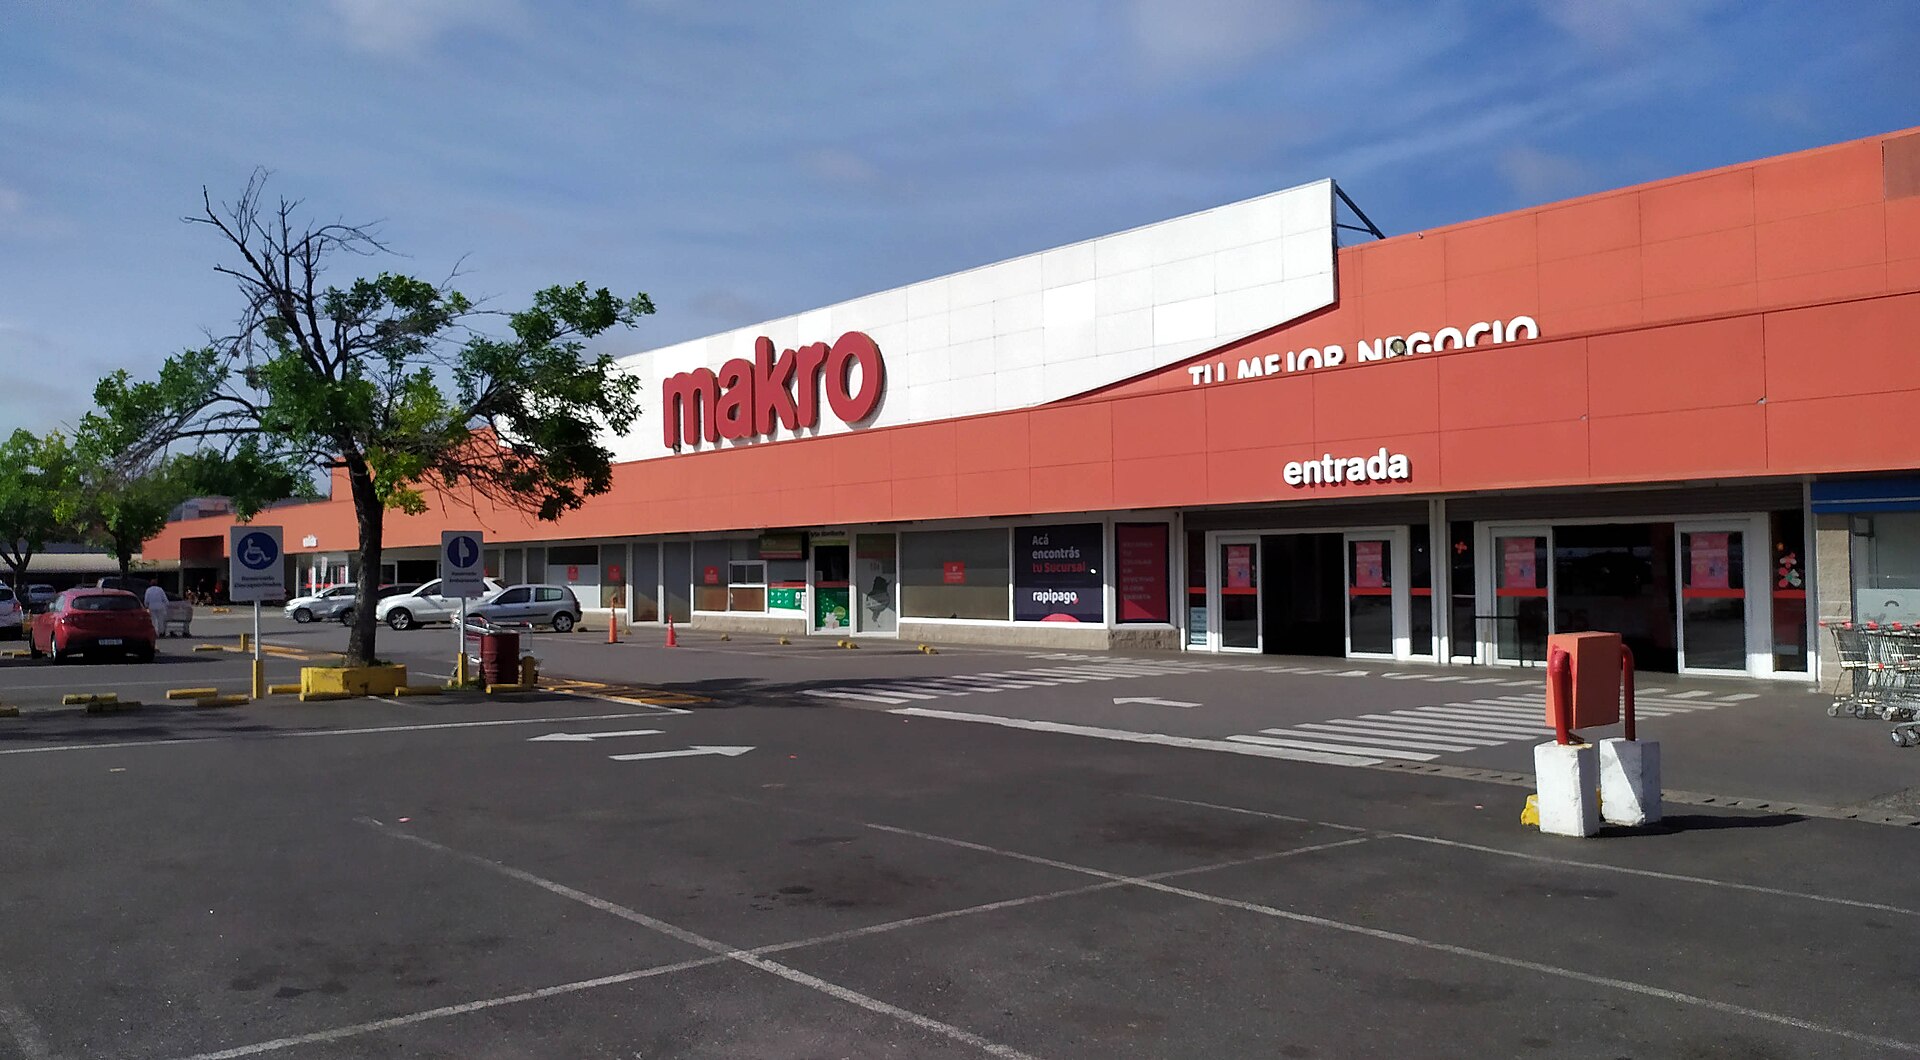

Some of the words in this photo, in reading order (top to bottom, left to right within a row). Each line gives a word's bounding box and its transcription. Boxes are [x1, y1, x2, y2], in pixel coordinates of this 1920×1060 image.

[662, 330, 886, 449] makro
[1283, 447, 1411, 486] entrada
[1032, 533, 1049, 546] Acá
[1032, 546, 1080, 559] encontrás
[1032, 562, 1043, 573] tu
[1044, 561, 1086, 573] Sucursal
[1032, 589, 1078, 604] rapipago
